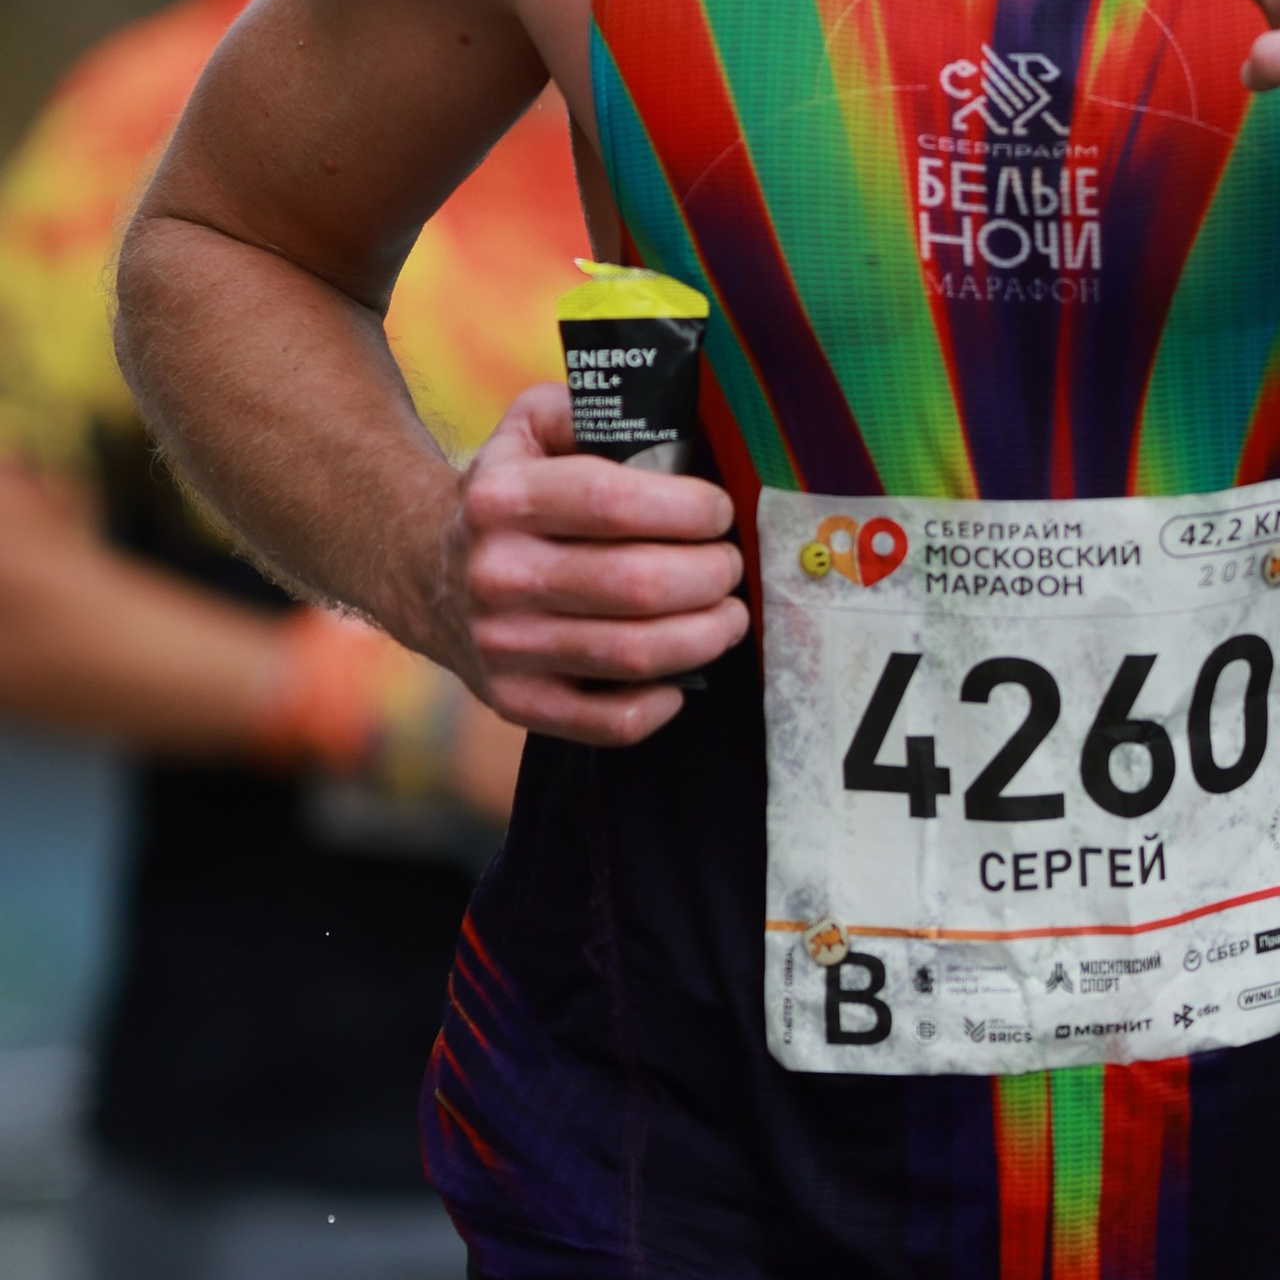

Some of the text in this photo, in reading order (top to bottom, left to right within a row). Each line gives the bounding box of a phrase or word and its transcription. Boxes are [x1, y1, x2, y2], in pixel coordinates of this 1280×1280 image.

[917, 132, 1099, 158] СБЕРПРАЙМ
[918, 156, 1099, 217] БЕЛЫЕ
[920, 211, 1101, 270] НОЧИ
[924, 271, 1099, 304] МАРАФОН
[566, 348, 657, 369] ENERGY
[568, 371, 623, 390] GEL+
[571, 407, 622, 419] RGININE
[572, 417, 647, 430] ETA ALANINE
[633, 428, 678, 441] MALATE
[924, 519, 1082, 540] СБЕРПРАЙМ
[1179, 518, 1242, 547] 42,2
[925, 540, 1142, 569] МОСКОВСКИЙ
[1198, 555, 1257, 587] 202
[925, 573, 1083, 597] МАРАФОН
[843, 634, 1274, 823] 4260
[980, 834, 1167, 893] СЕРГЕЙ
[1080, 950, 1162, 975] МОСКОВСКИЙ
[1206, 940, 1250, 963] СБЕР
[1080, 977, 1120, 994] СПОРТ
[988, 1032, 1033, 1043] BRICS
